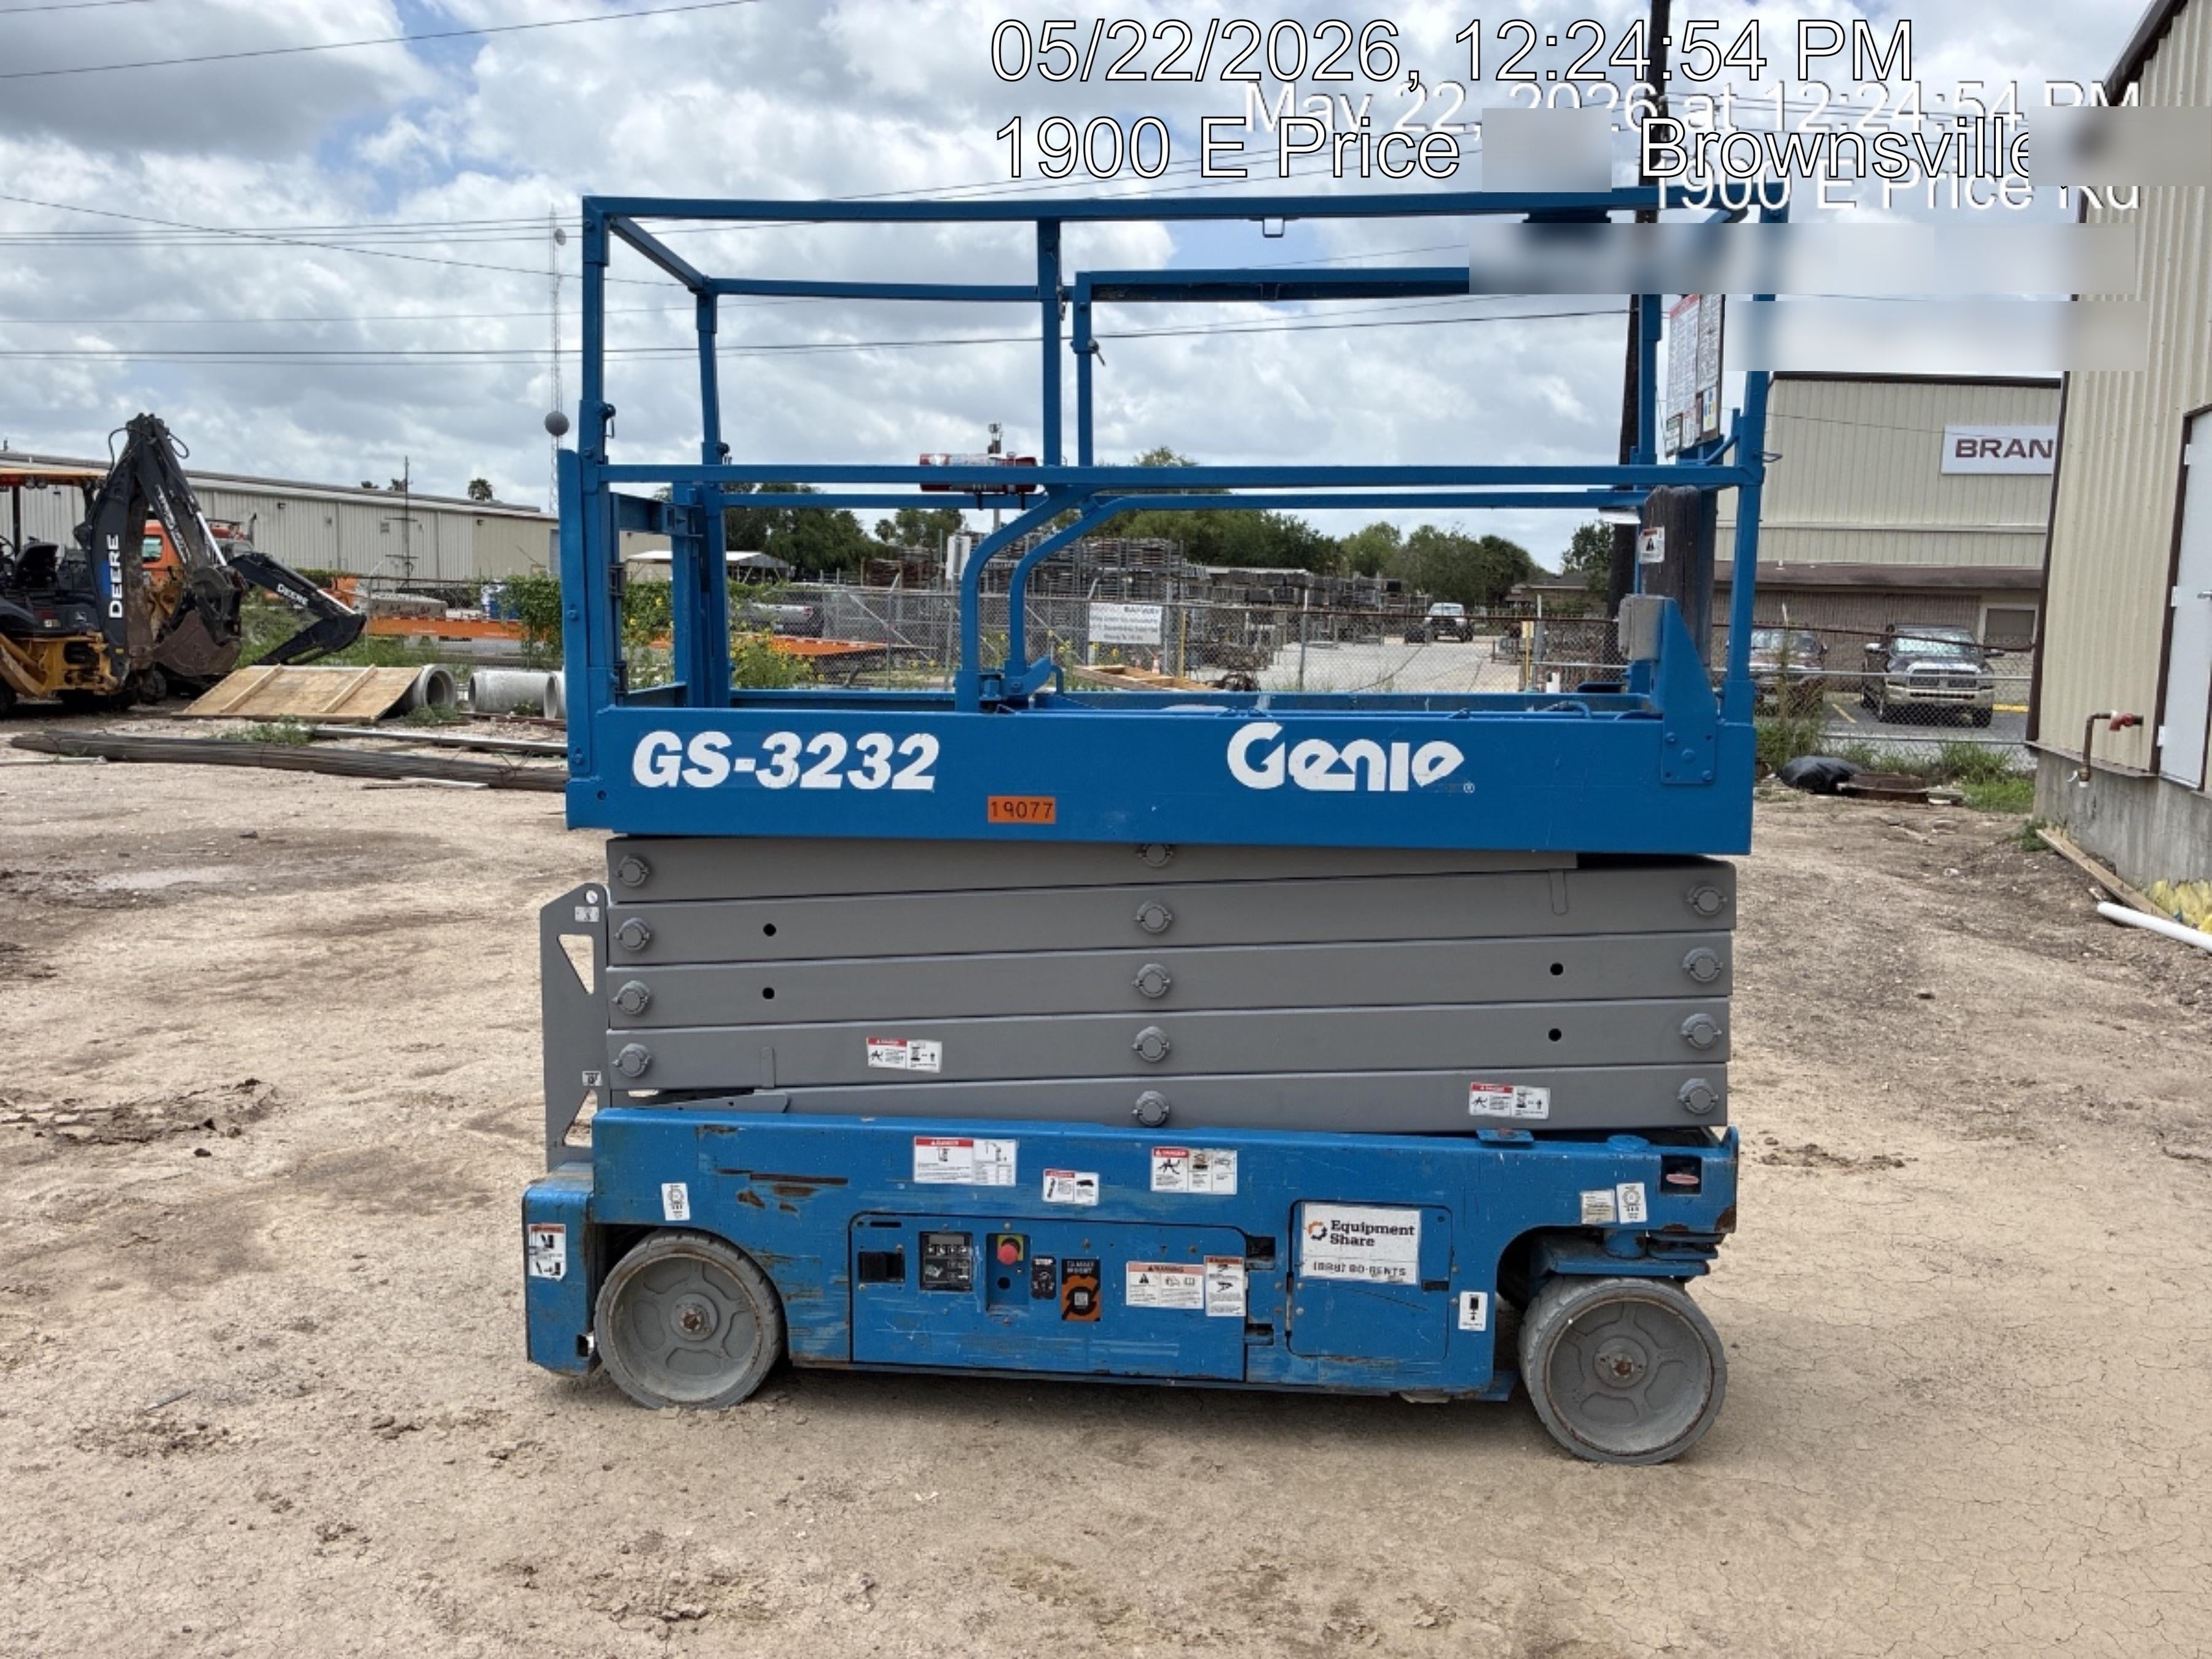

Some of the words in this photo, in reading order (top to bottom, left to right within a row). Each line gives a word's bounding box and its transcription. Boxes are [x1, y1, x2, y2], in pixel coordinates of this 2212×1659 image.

[1955, 438, 2053, 458] BRAN
[106, 534, 123, 618] DEERE
[632, 730, 939, 790] GS-3232
[1227, 721, 1465, 791] Genie
[990, 801, 1053, 819] 19077
[1330, 1220, 1416, 1236] Equipment
[1330, 1233, 1376, 1247] Share
